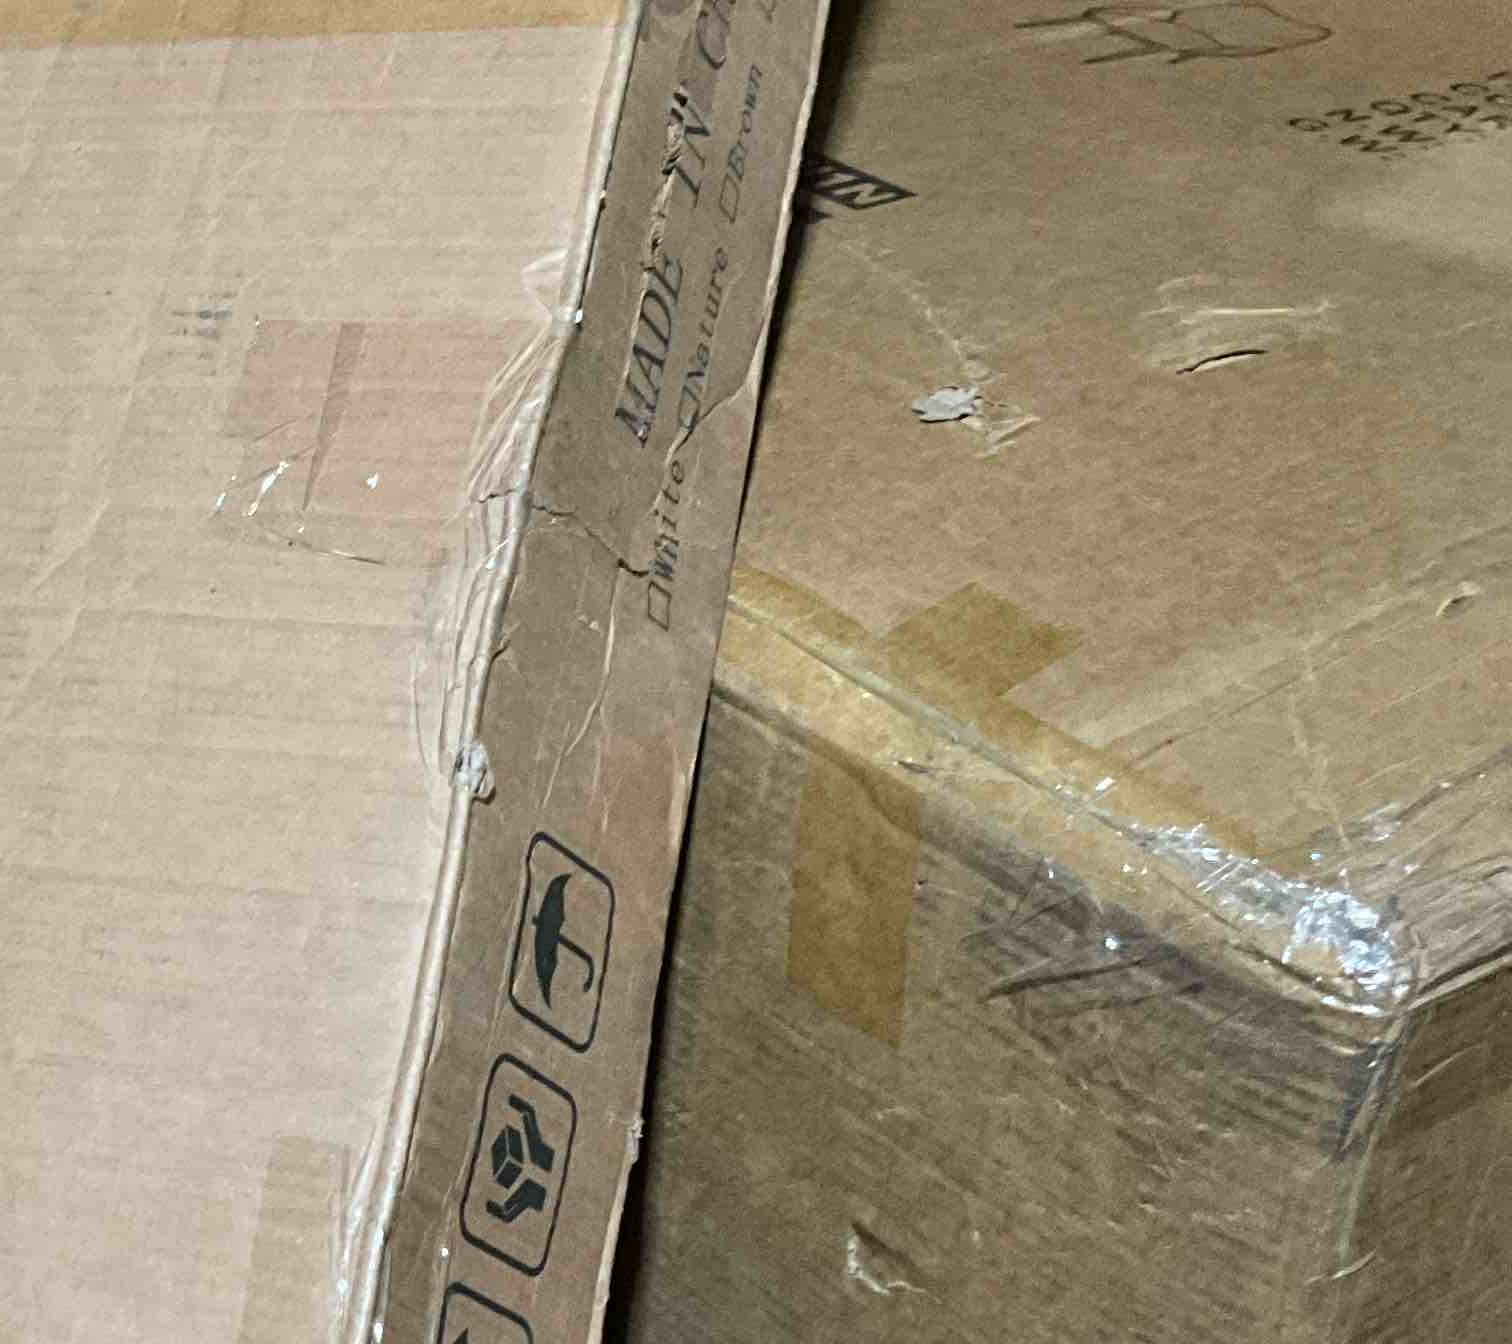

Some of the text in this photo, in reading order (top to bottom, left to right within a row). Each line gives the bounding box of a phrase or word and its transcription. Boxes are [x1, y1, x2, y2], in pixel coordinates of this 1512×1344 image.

[730, 63, 762, 182] Brown
[614, 253, 683, 448] MADE
[684, 245, 729, 395] Nature
